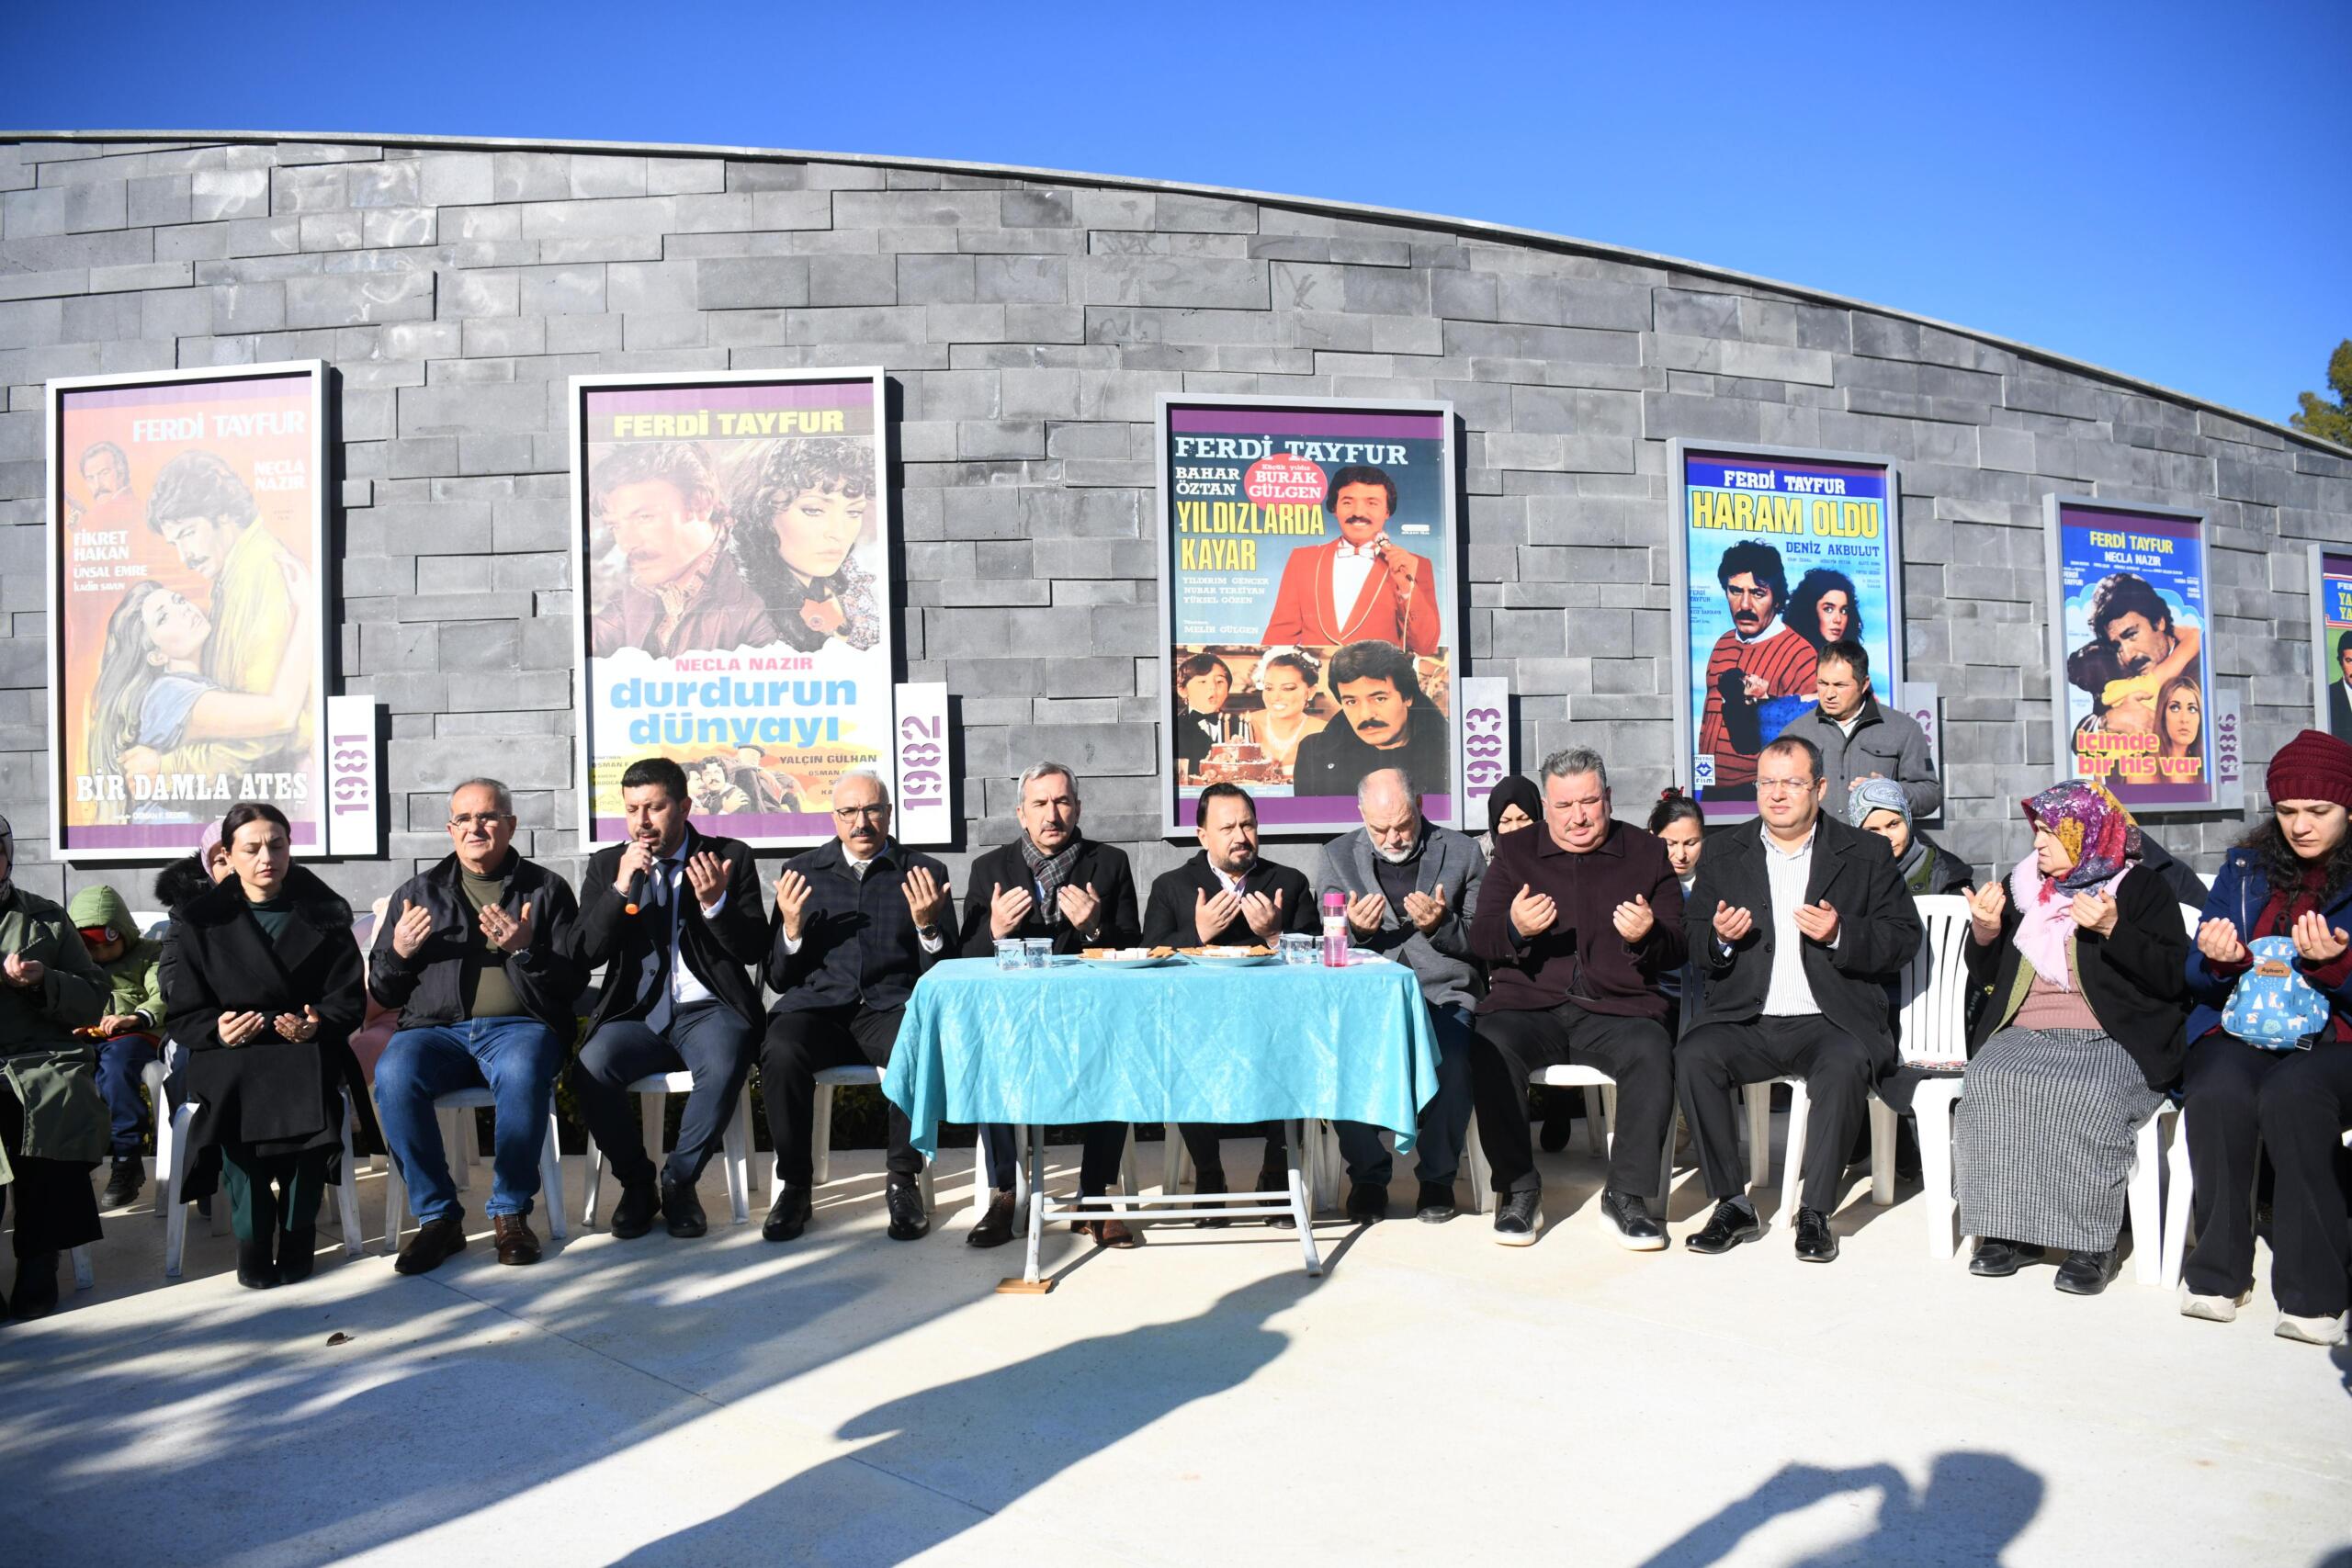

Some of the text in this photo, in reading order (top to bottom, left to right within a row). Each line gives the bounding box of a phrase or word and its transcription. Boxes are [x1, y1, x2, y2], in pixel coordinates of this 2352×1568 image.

[132, 411, 306, 442] FERDİ TAYFUR
[614, 410, 844, 437] FERDİ TAYFUR
[1175, 434, 1408, 465] FERDİ TAYFUR
[254, 459, 306, 476] NECLA
[1175, 467, 1240, 480] BAHAR
[1255, 470, 1318, 483] BURAK
[1176, 480, 1237, 496] ÖZTAN
[1249, 483, 1322, 499] GÜLGEN
[1724, 469, 1846, 494] FERDİ TAYFUR
[1176, 501, 1326, 536] YILDIZLARDA
[1691, 491, 1879, 539] HARAM OLDU
[74, 528, 128, 546] FİKRET
[1785, 540, 1881, 557] DENİZ AKBULUT
[2089, 531, 2174, 554] FERDİ TAYFUR
[74, 546, 130, 561] HAKAN
[1182, 537, 1257, 571] KAYAR
[2105, 551, 2132, 564] NECLA
[2135, 553, 2162, 567] NAZIR
[114, 564, 148, 577] EMRE
[675, 657, 814, 671] NECLA NAZIR
[610, 676, 857, 708] durdurun
[629, 712, 840, 748] dünyayı
[2077, 728, 2159, 753] içimde
[779, 753, 877, 765] YALÇIN GÜLHAN
[901, 716, 943, 810] 1982
[1465, 708, 1502, 798] 1983
[2078, 753, 2202, 775] bir his var
[75, 768, 309, 805] BİR DAMLA ATEŞ
[334, 734, 369, 816] 1981
